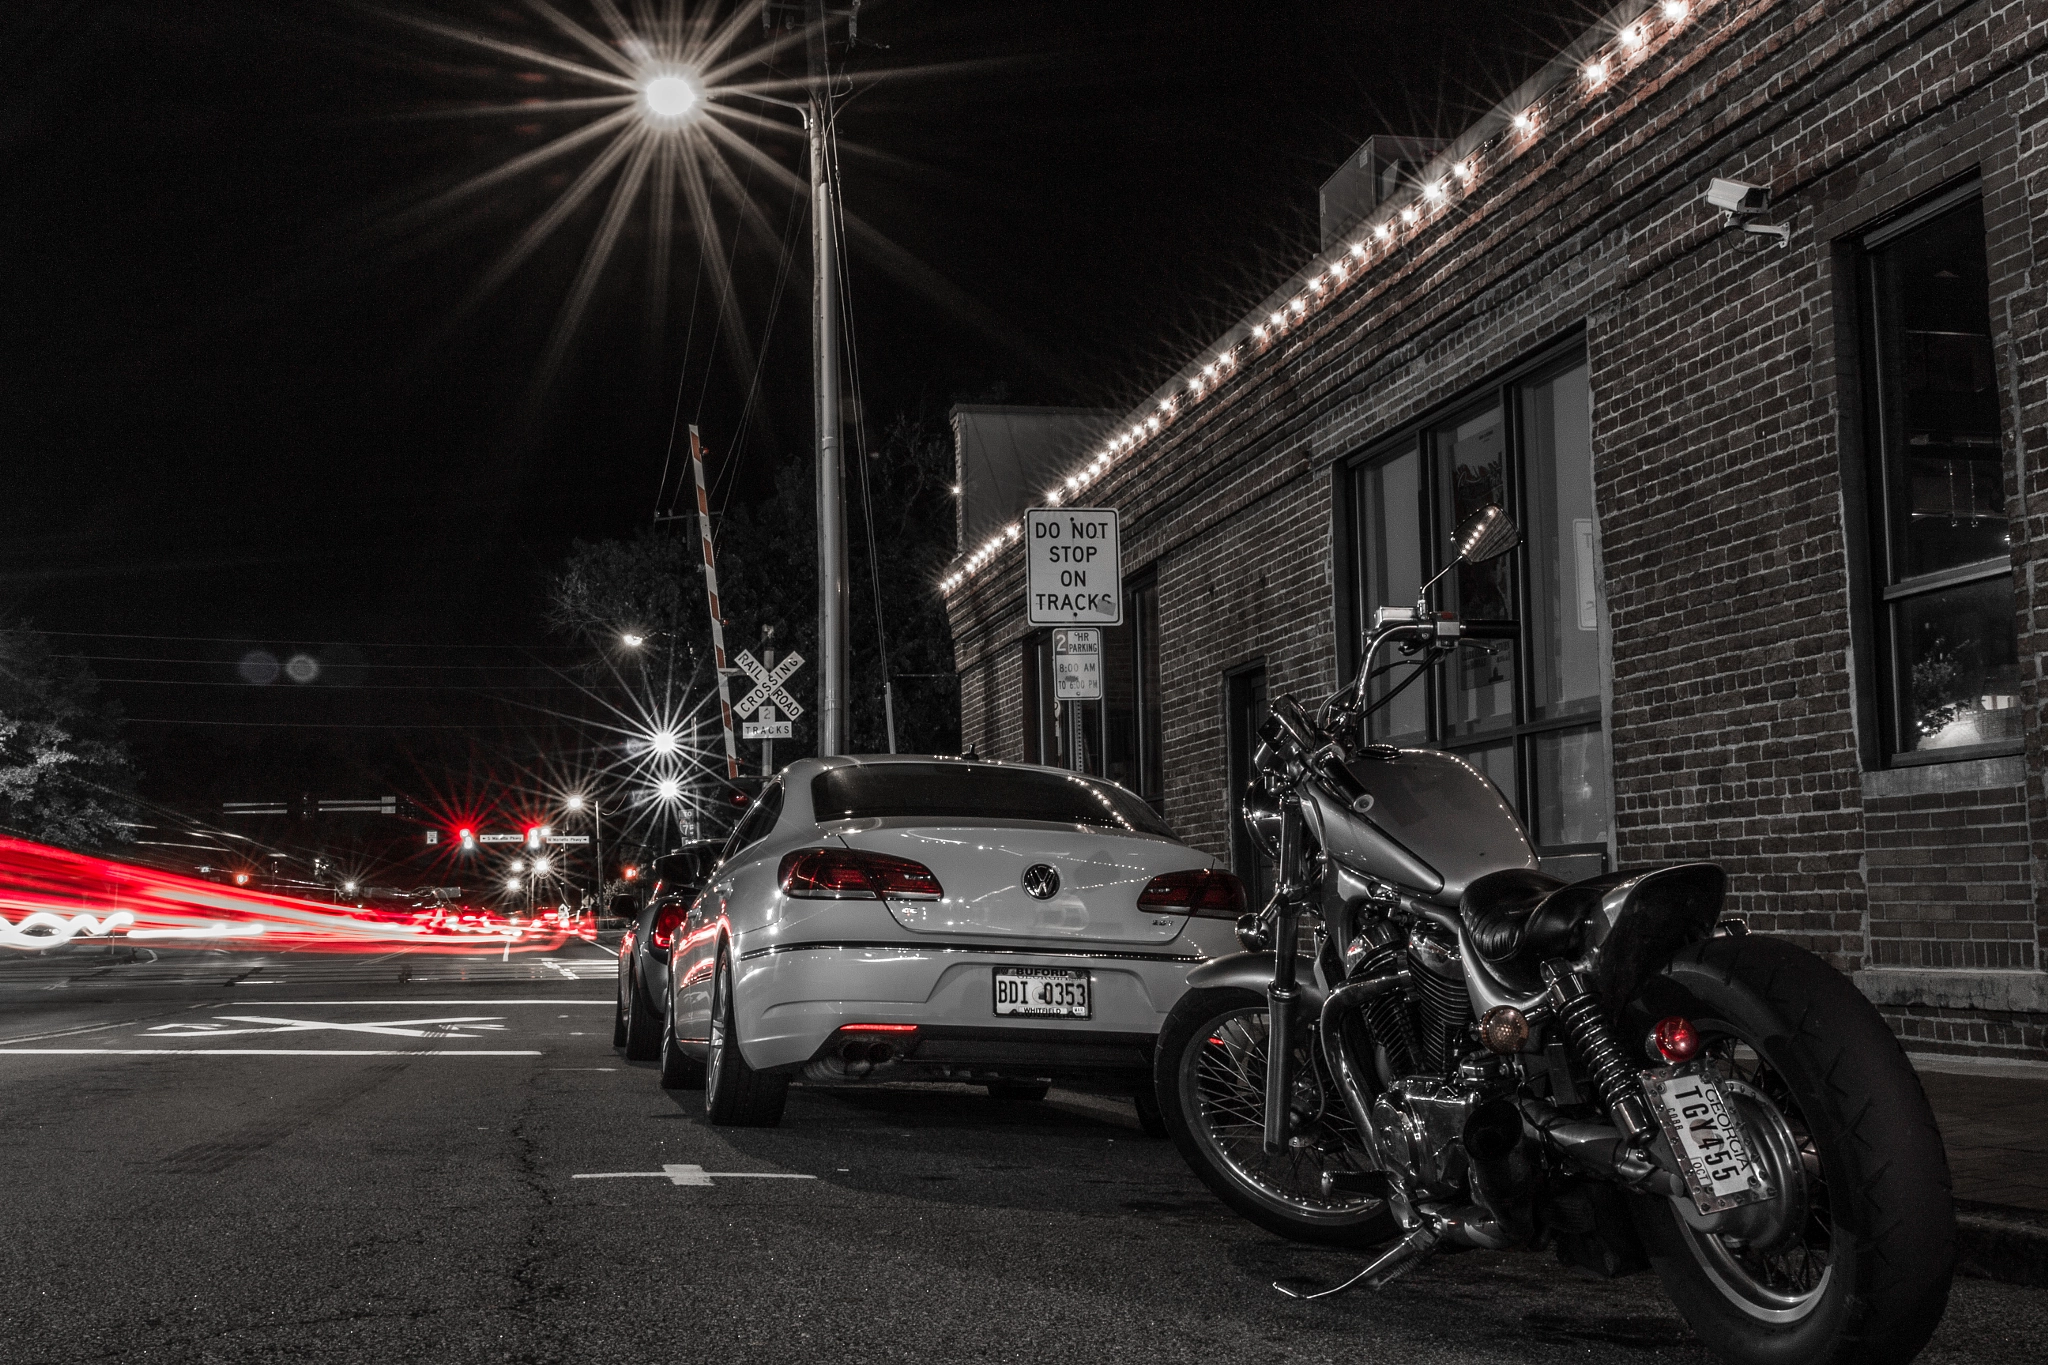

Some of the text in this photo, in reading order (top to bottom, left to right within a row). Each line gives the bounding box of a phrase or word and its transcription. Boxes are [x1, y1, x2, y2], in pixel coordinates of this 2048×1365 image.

[1035, 522, 1108, 539] DO NOT
[1049, 546, 1098, 563] STOP
[1060, 570, 1086, 587] ON
[1056, 634, 1067, 652] 2
[1077, 632, 1089, 641] HR
[1069, 643, 1098, 653] PARKING
[737, 653, 763, 680] RAIL
[1059, 663, 1096, 672] 8:00 AM
[740, 657, 798, 712] CROSSING
[1058, 680, 1067, 689] TO
[1089, 679, 1098, 689] PM
[772, 688, 800, 717] ROAD
[763, 707, 771, 719] 2
[745, 725, 790, 735] TRACKS
[1016, 968, 1068, 977] BUFORD
[998, 980, 1086, 1006] BDI 0353
[1675, 1085, 1740, 1181] TGY455
[1705, 1089, 1750, 1171] GEORGIA
[1693, 1161, 1709, 1182] OCT
